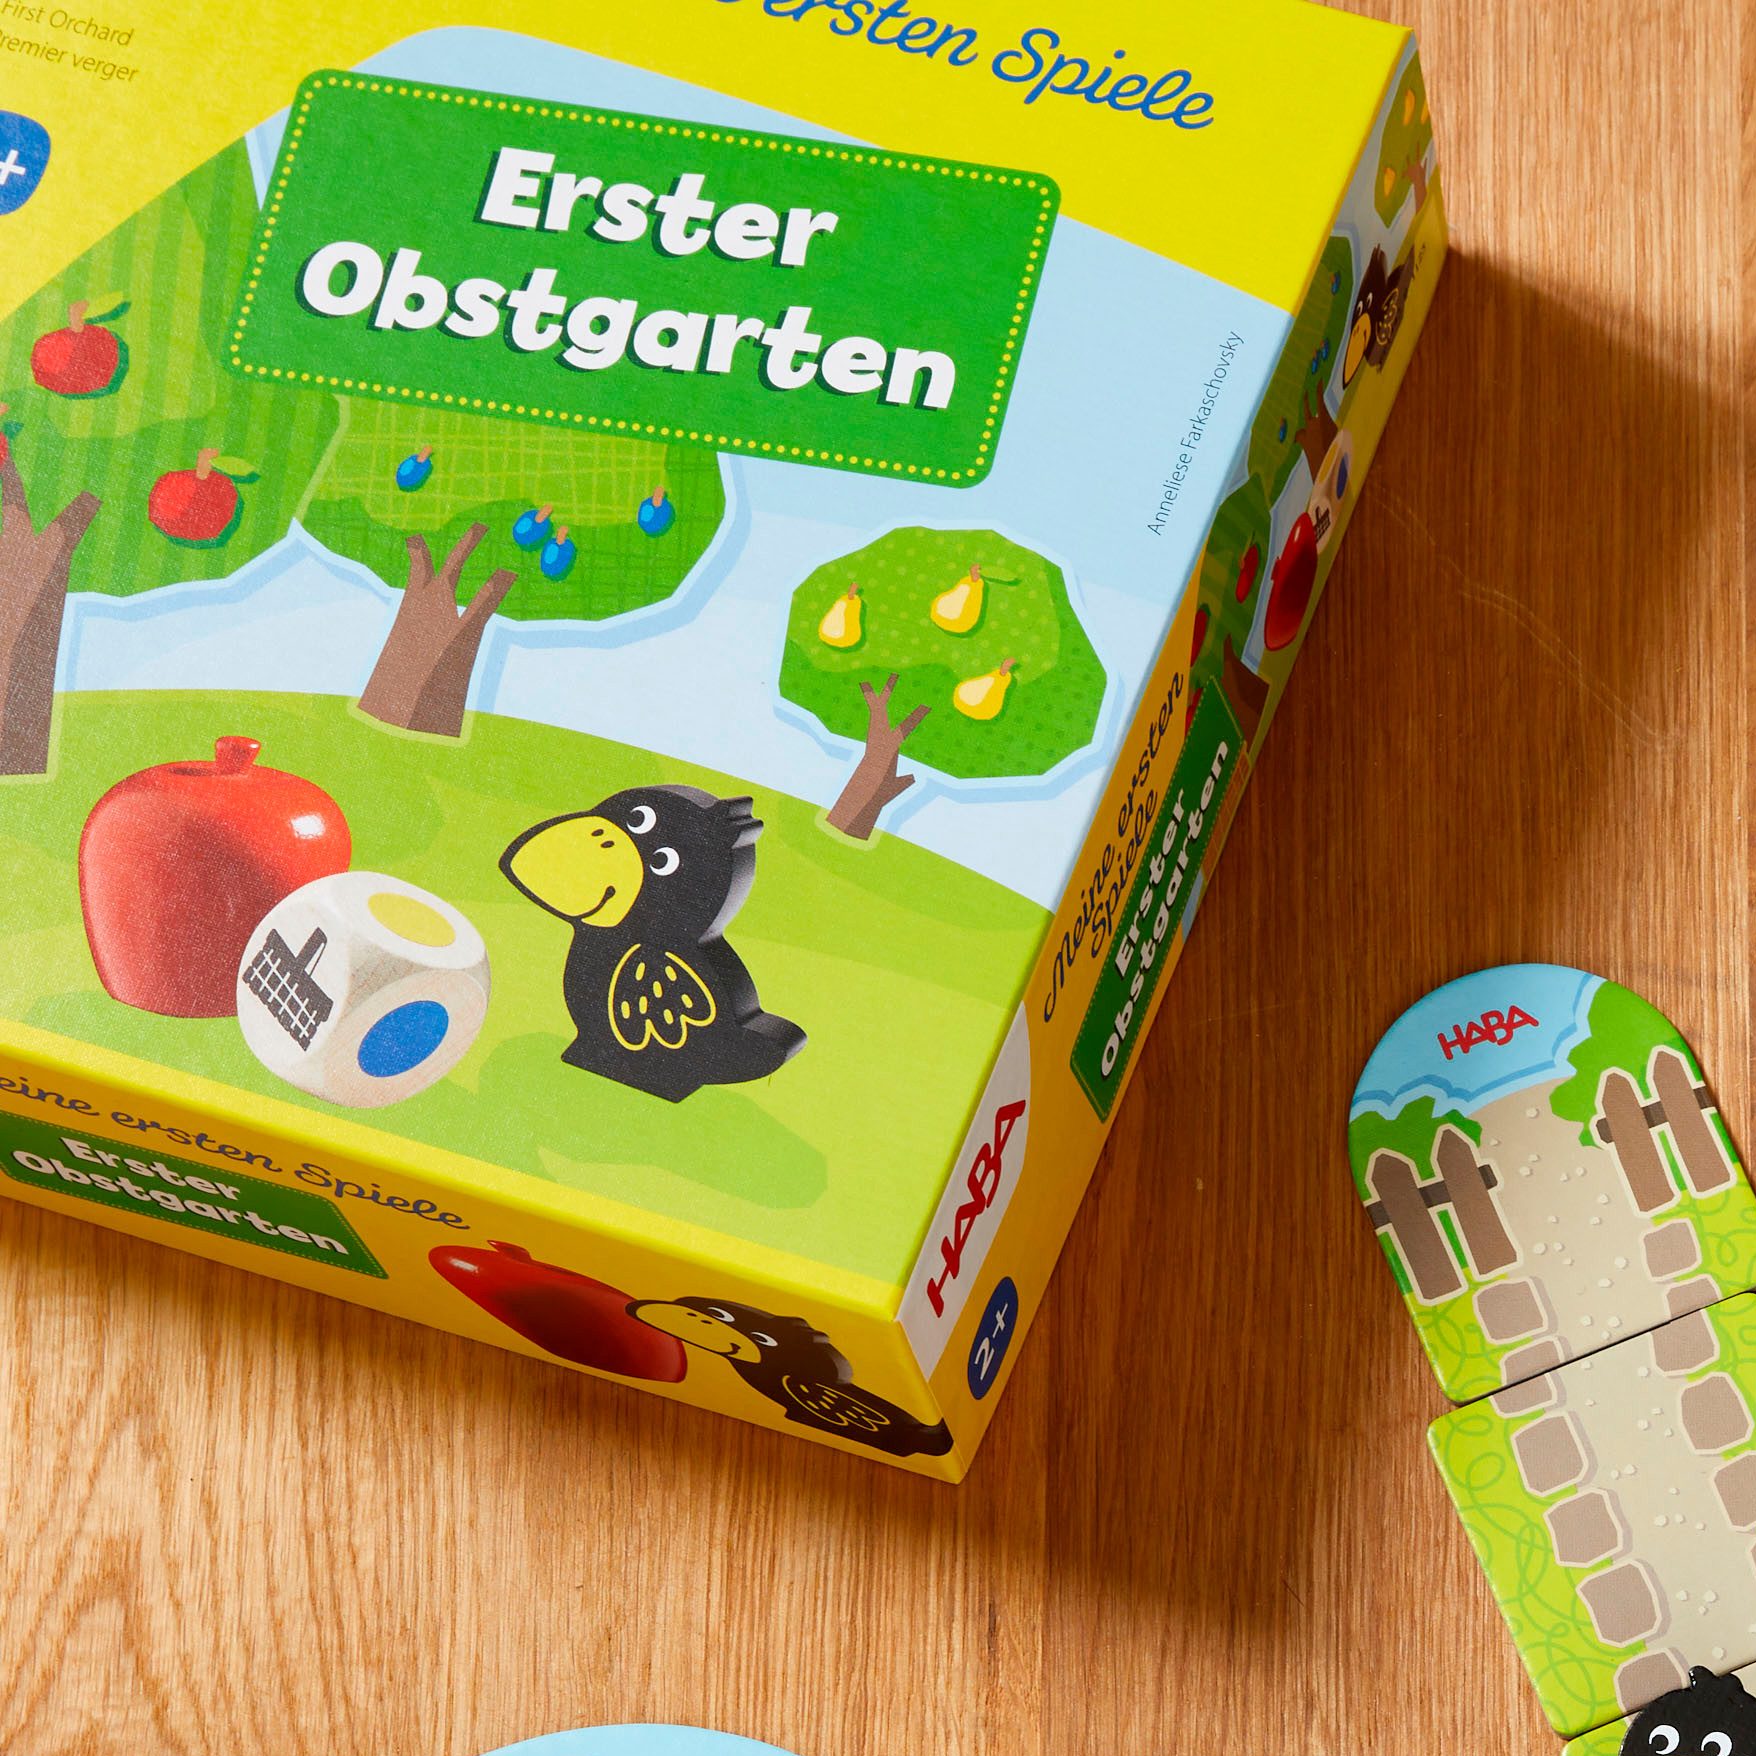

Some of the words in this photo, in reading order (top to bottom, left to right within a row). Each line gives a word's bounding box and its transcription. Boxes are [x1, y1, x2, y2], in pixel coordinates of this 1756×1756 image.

[0, 29, 68, 63] remier
[72, 53, 139, 82] verger
[1, 0, 45, 24] First
[49, 10, 135, 46] Orchard
[992, 28, 1214, 130] Spiele
[474, 147, 839, 267] Erster
[302, 241, 957, 410] Obstgarten
[1147, 453, 1193, 536] Anneliese
[1180, 330, 1245, 449] Farkaschovsky
[1043, 842, 1115, 1024] Meine
[1118, 671, 1184, 836] ersten
[1090, 789, 1158, 959] Spiele
[1114, 787, 1184, 978] Erster
[1100, 740, 1229, 1077] Obstgarten
[1437, 1005, 1540, 1060] HABA
[11, 1150, 349, 1256] Obstgarten
[59, 1136, 241, 1201] Erster
[111, 1111, 283, 1172] ersten
[294, 1162, 471, 1230] Spiele
[927, 1099, 1026, 1318] HABA
[974, 1302, 1009, 1381] 2+
